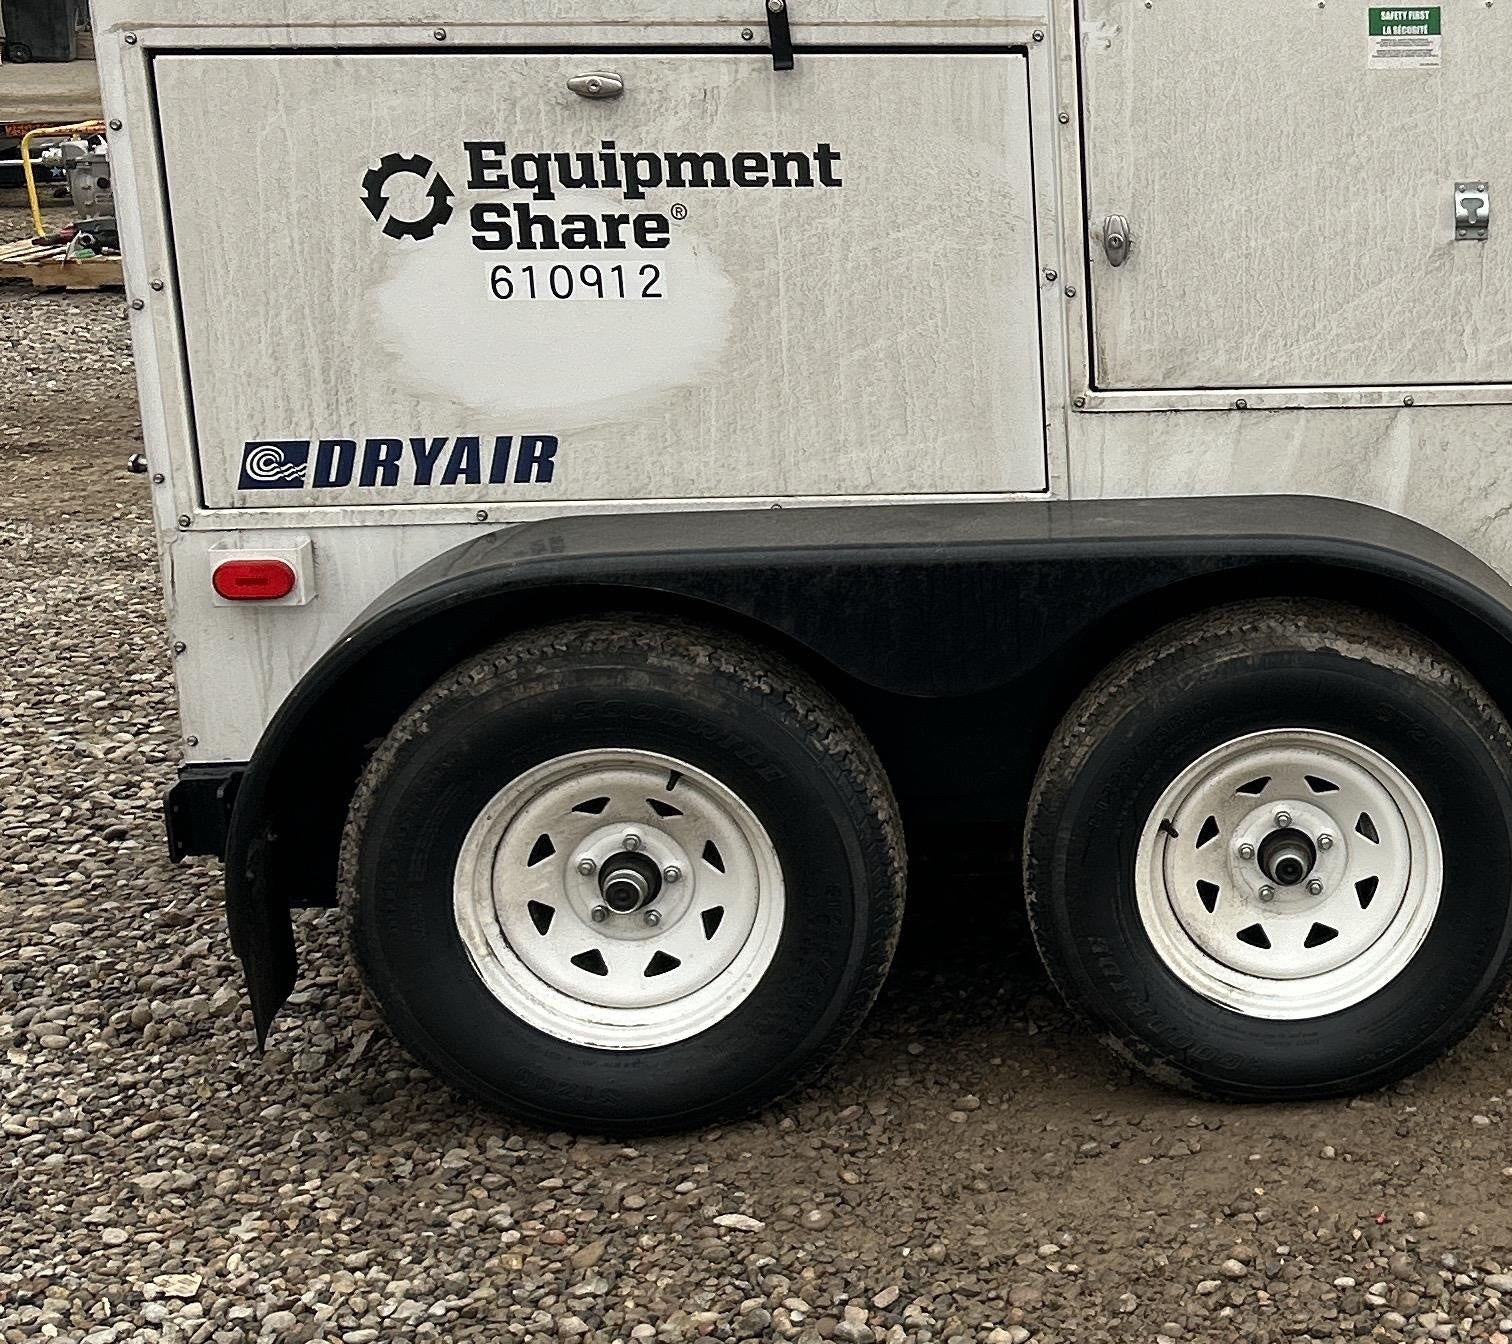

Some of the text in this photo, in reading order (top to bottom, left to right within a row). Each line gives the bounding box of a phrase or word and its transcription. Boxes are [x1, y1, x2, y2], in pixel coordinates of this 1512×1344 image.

[1380, 10, 1430, 21] SAFETY FIRST
[1382, 25, 1392, 35] LA
[463, 140, 843, 201] Equipment
[490, 263, 663, 300] 610912
[311, 434, 559, 489] DRYAIR
